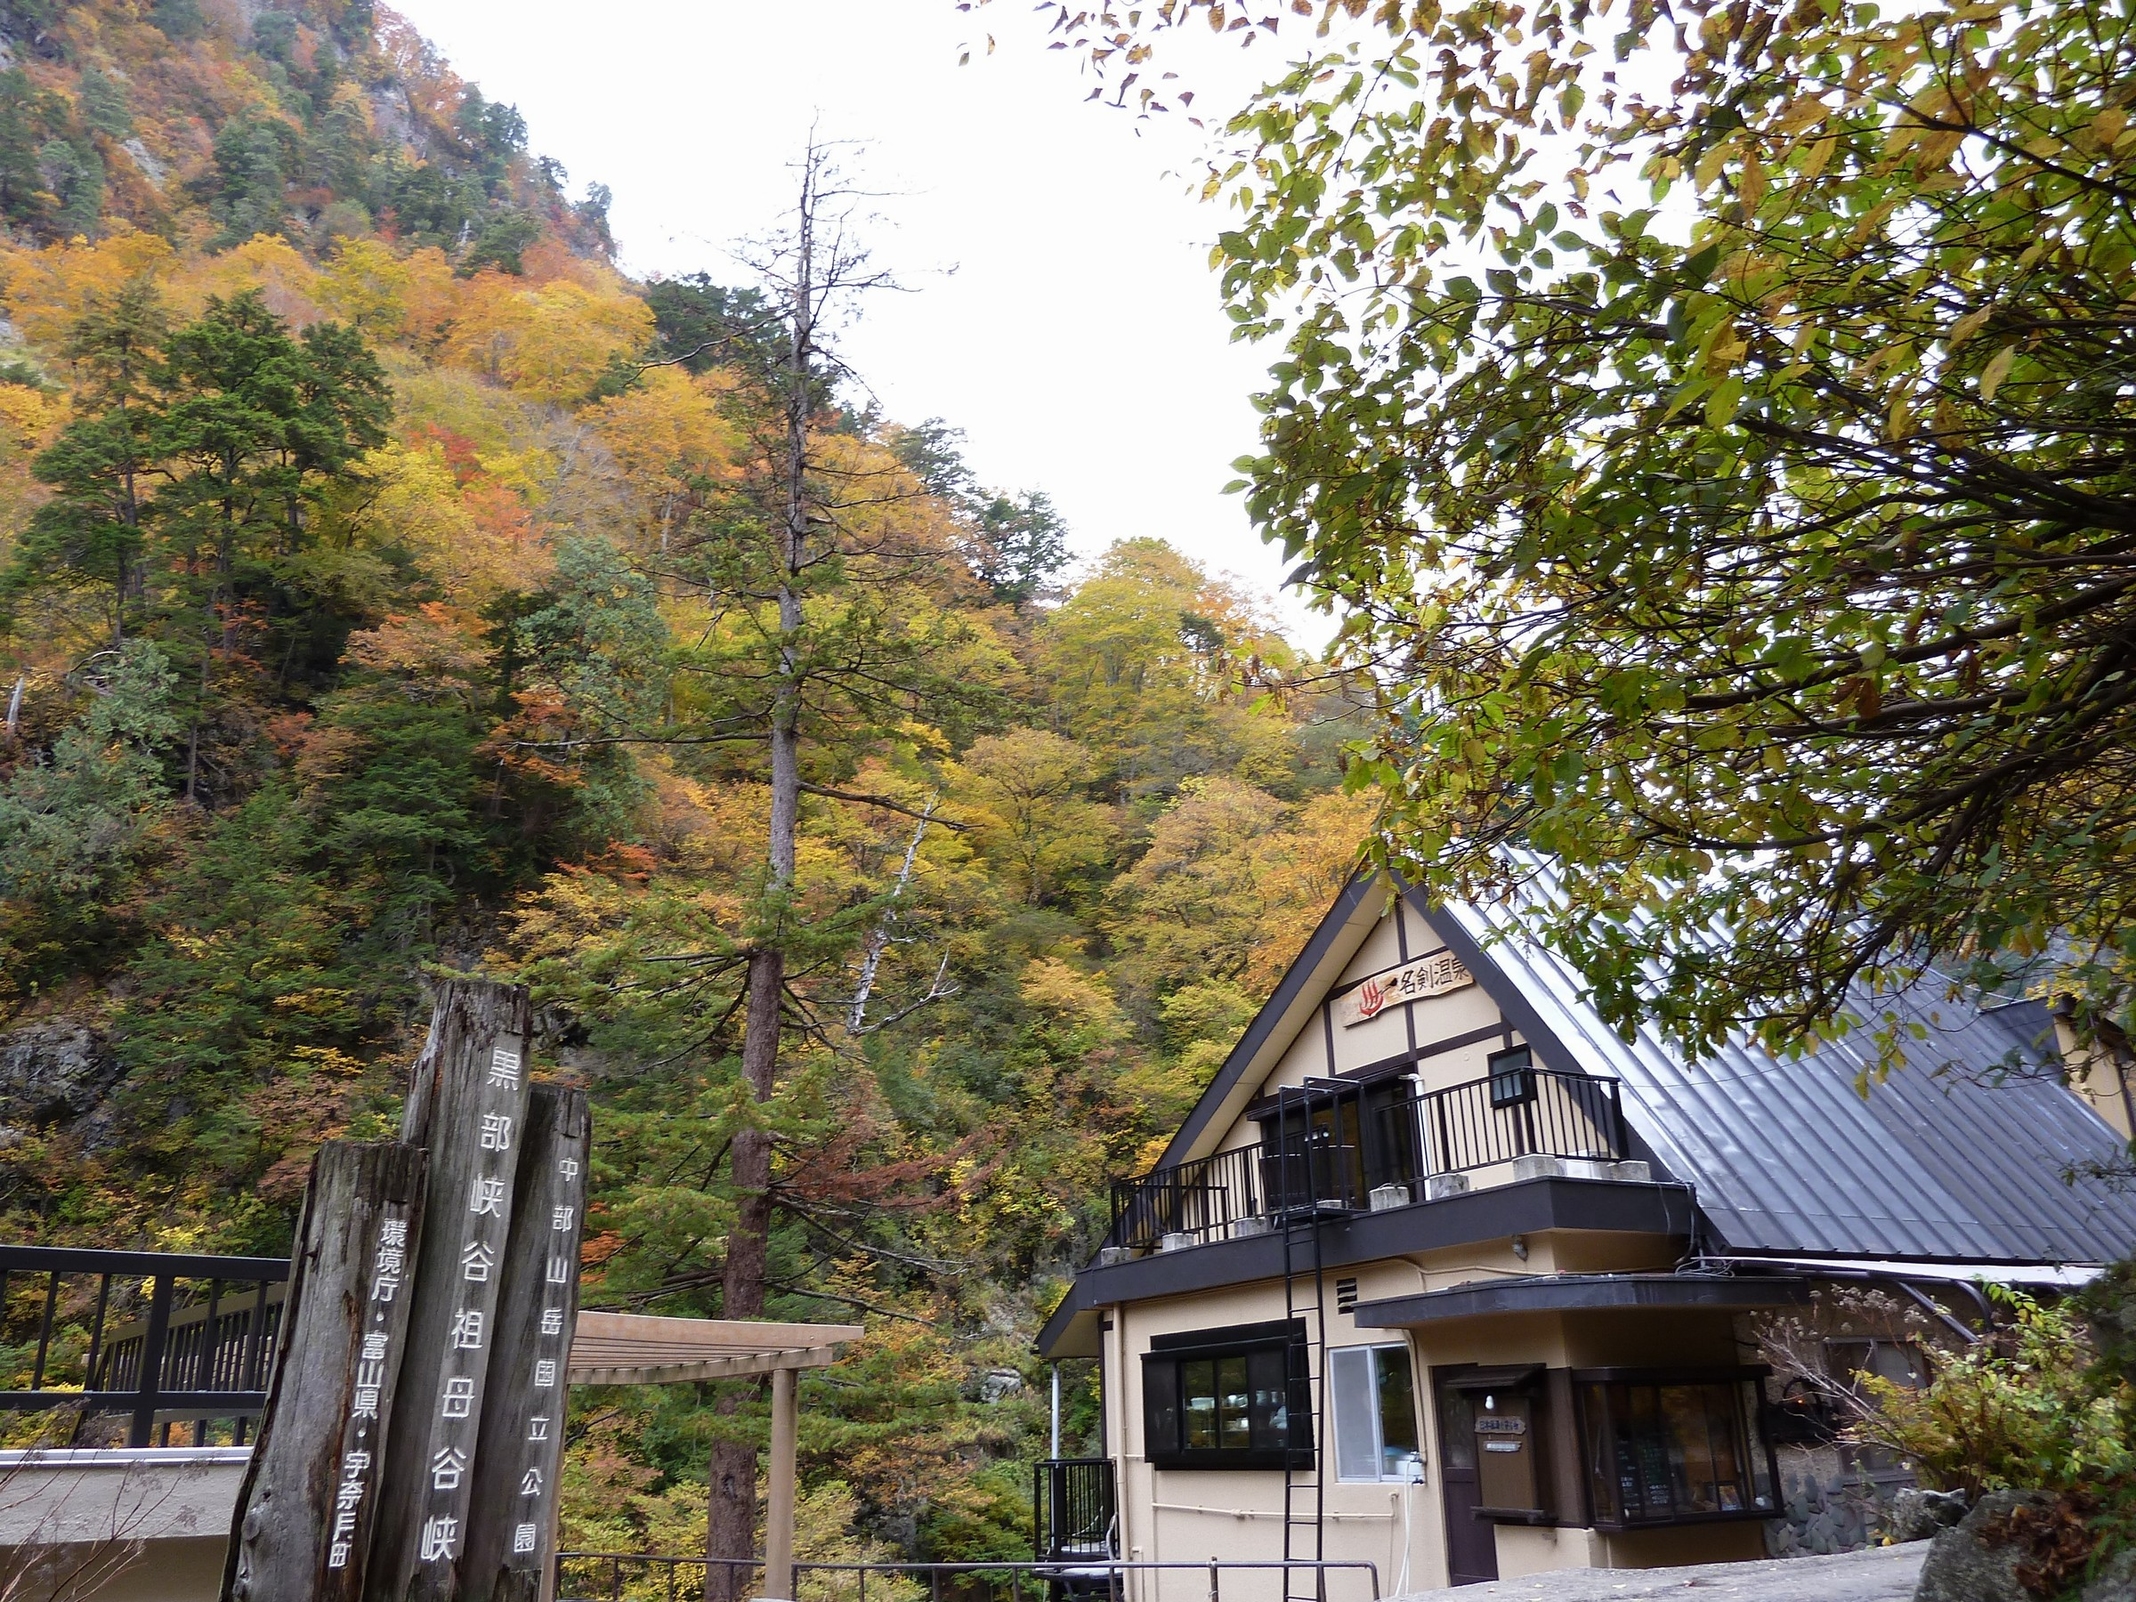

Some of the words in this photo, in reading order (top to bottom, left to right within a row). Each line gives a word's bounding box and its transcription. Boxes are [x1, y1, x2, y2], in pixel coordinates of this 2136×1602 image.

[420, 1046, 522, 1562] 黒部峡谷祖母谷峡
[514, 1157, 578, 1553] 中部山岳国立公園
